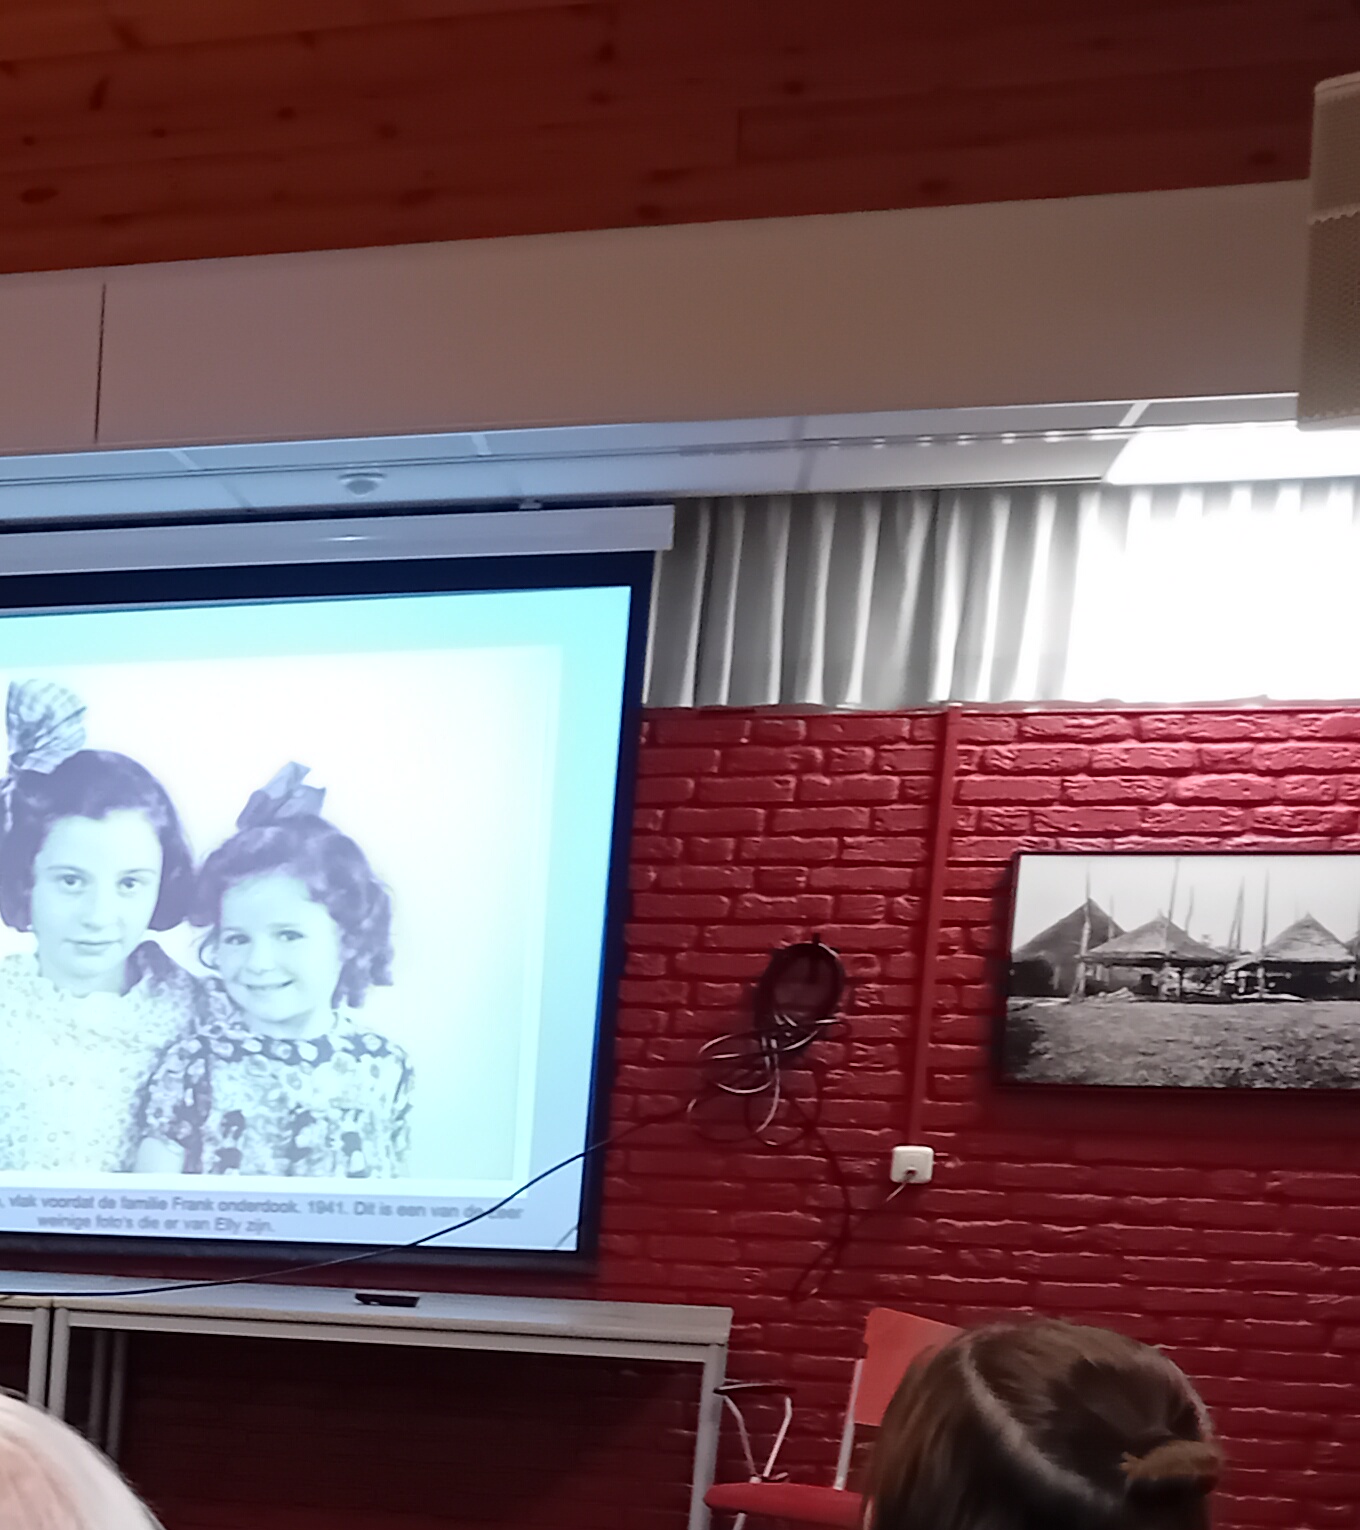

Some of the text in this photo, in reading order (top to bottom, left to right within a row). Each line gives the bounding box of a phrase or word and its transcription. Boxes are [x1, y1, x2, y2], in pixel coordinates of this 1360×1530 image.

[9, 1194, 37, 1208] vlak
[42, 1195, 94, 1209] voordat
[98, 1196, 116, 1210] de
[121, 1196, 168, 1210] familie
[172, 1196, 214, 1211] Frank
[354, 1201, 375, 1216] Dit
[380, 1201, 392, 1217] is
[396, 1204, 426, 1218] een
[430, 1205, 459, 1218] van
[38, 1214, 91, 1231] weinige
[138, 1216, 160, 1230] die
[164, 1217, 179, 1230] er
[183, 1218, 210, 1231] van
[214, 1216, 241, 1234] Elly
